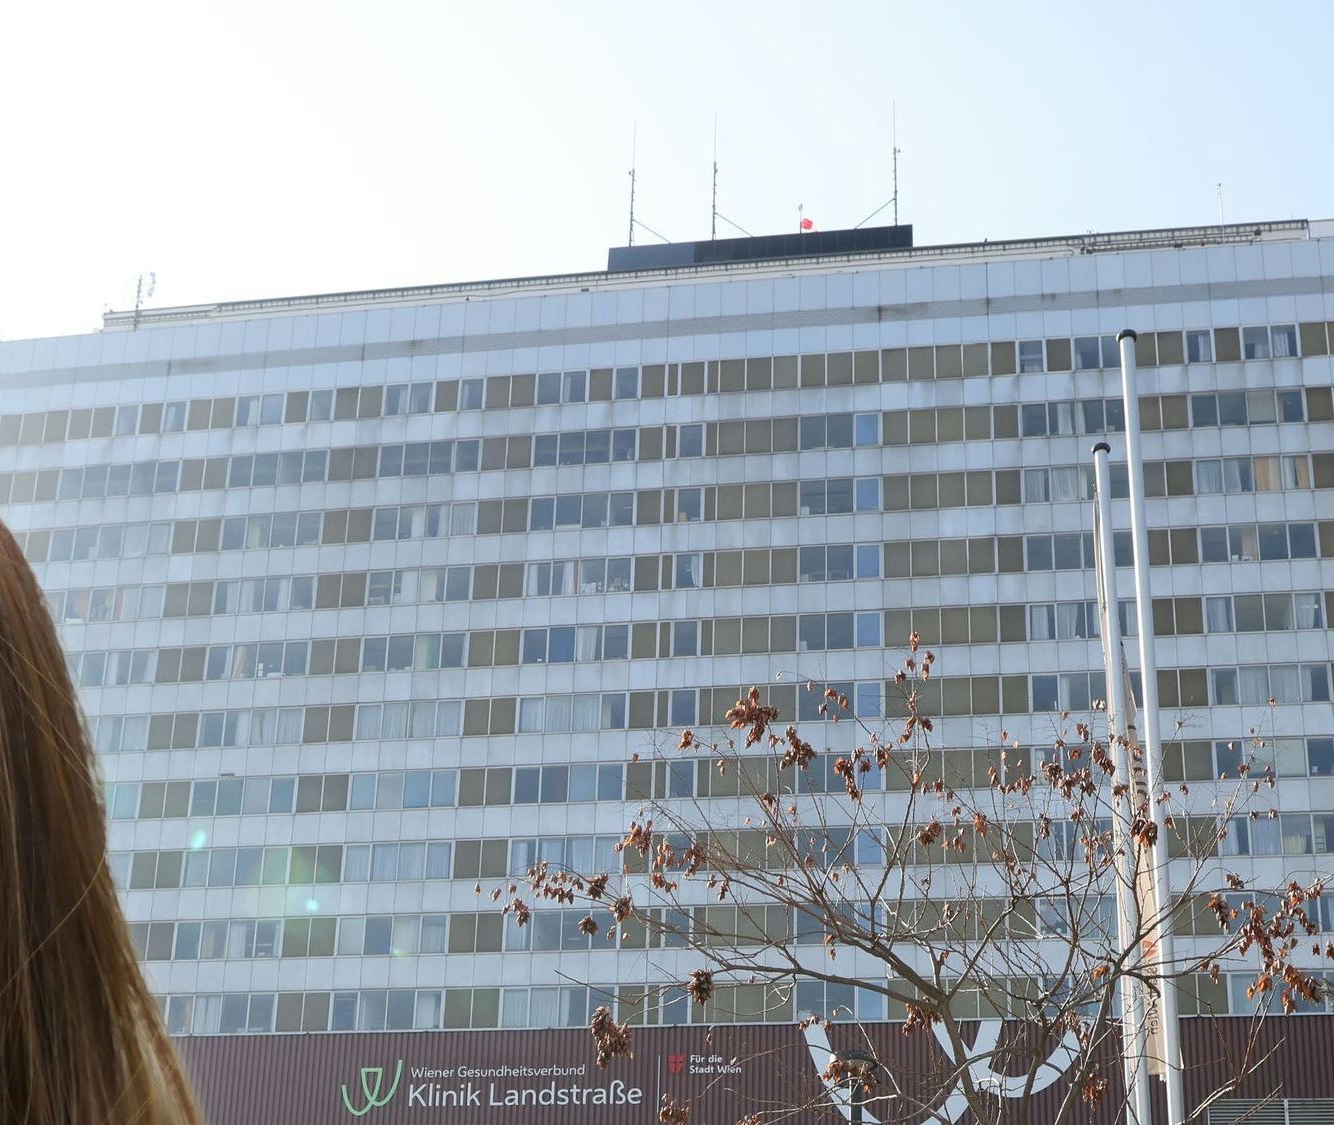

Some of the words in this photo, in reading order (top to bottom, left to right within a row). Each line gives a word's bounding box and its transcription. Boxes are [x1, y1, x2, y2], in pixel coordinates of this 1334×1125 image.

[691, 1055, 705, 1063] Für
[411, 1067, 454, 1078] Wiener
[458, 1064, 585, 1077] Gesundheitsverbund
[718, 1065, 741, 1074] Wien
[409, 1083, 480, 1106] Klinik
[490, 1080, 642, 1105] Landstraße
